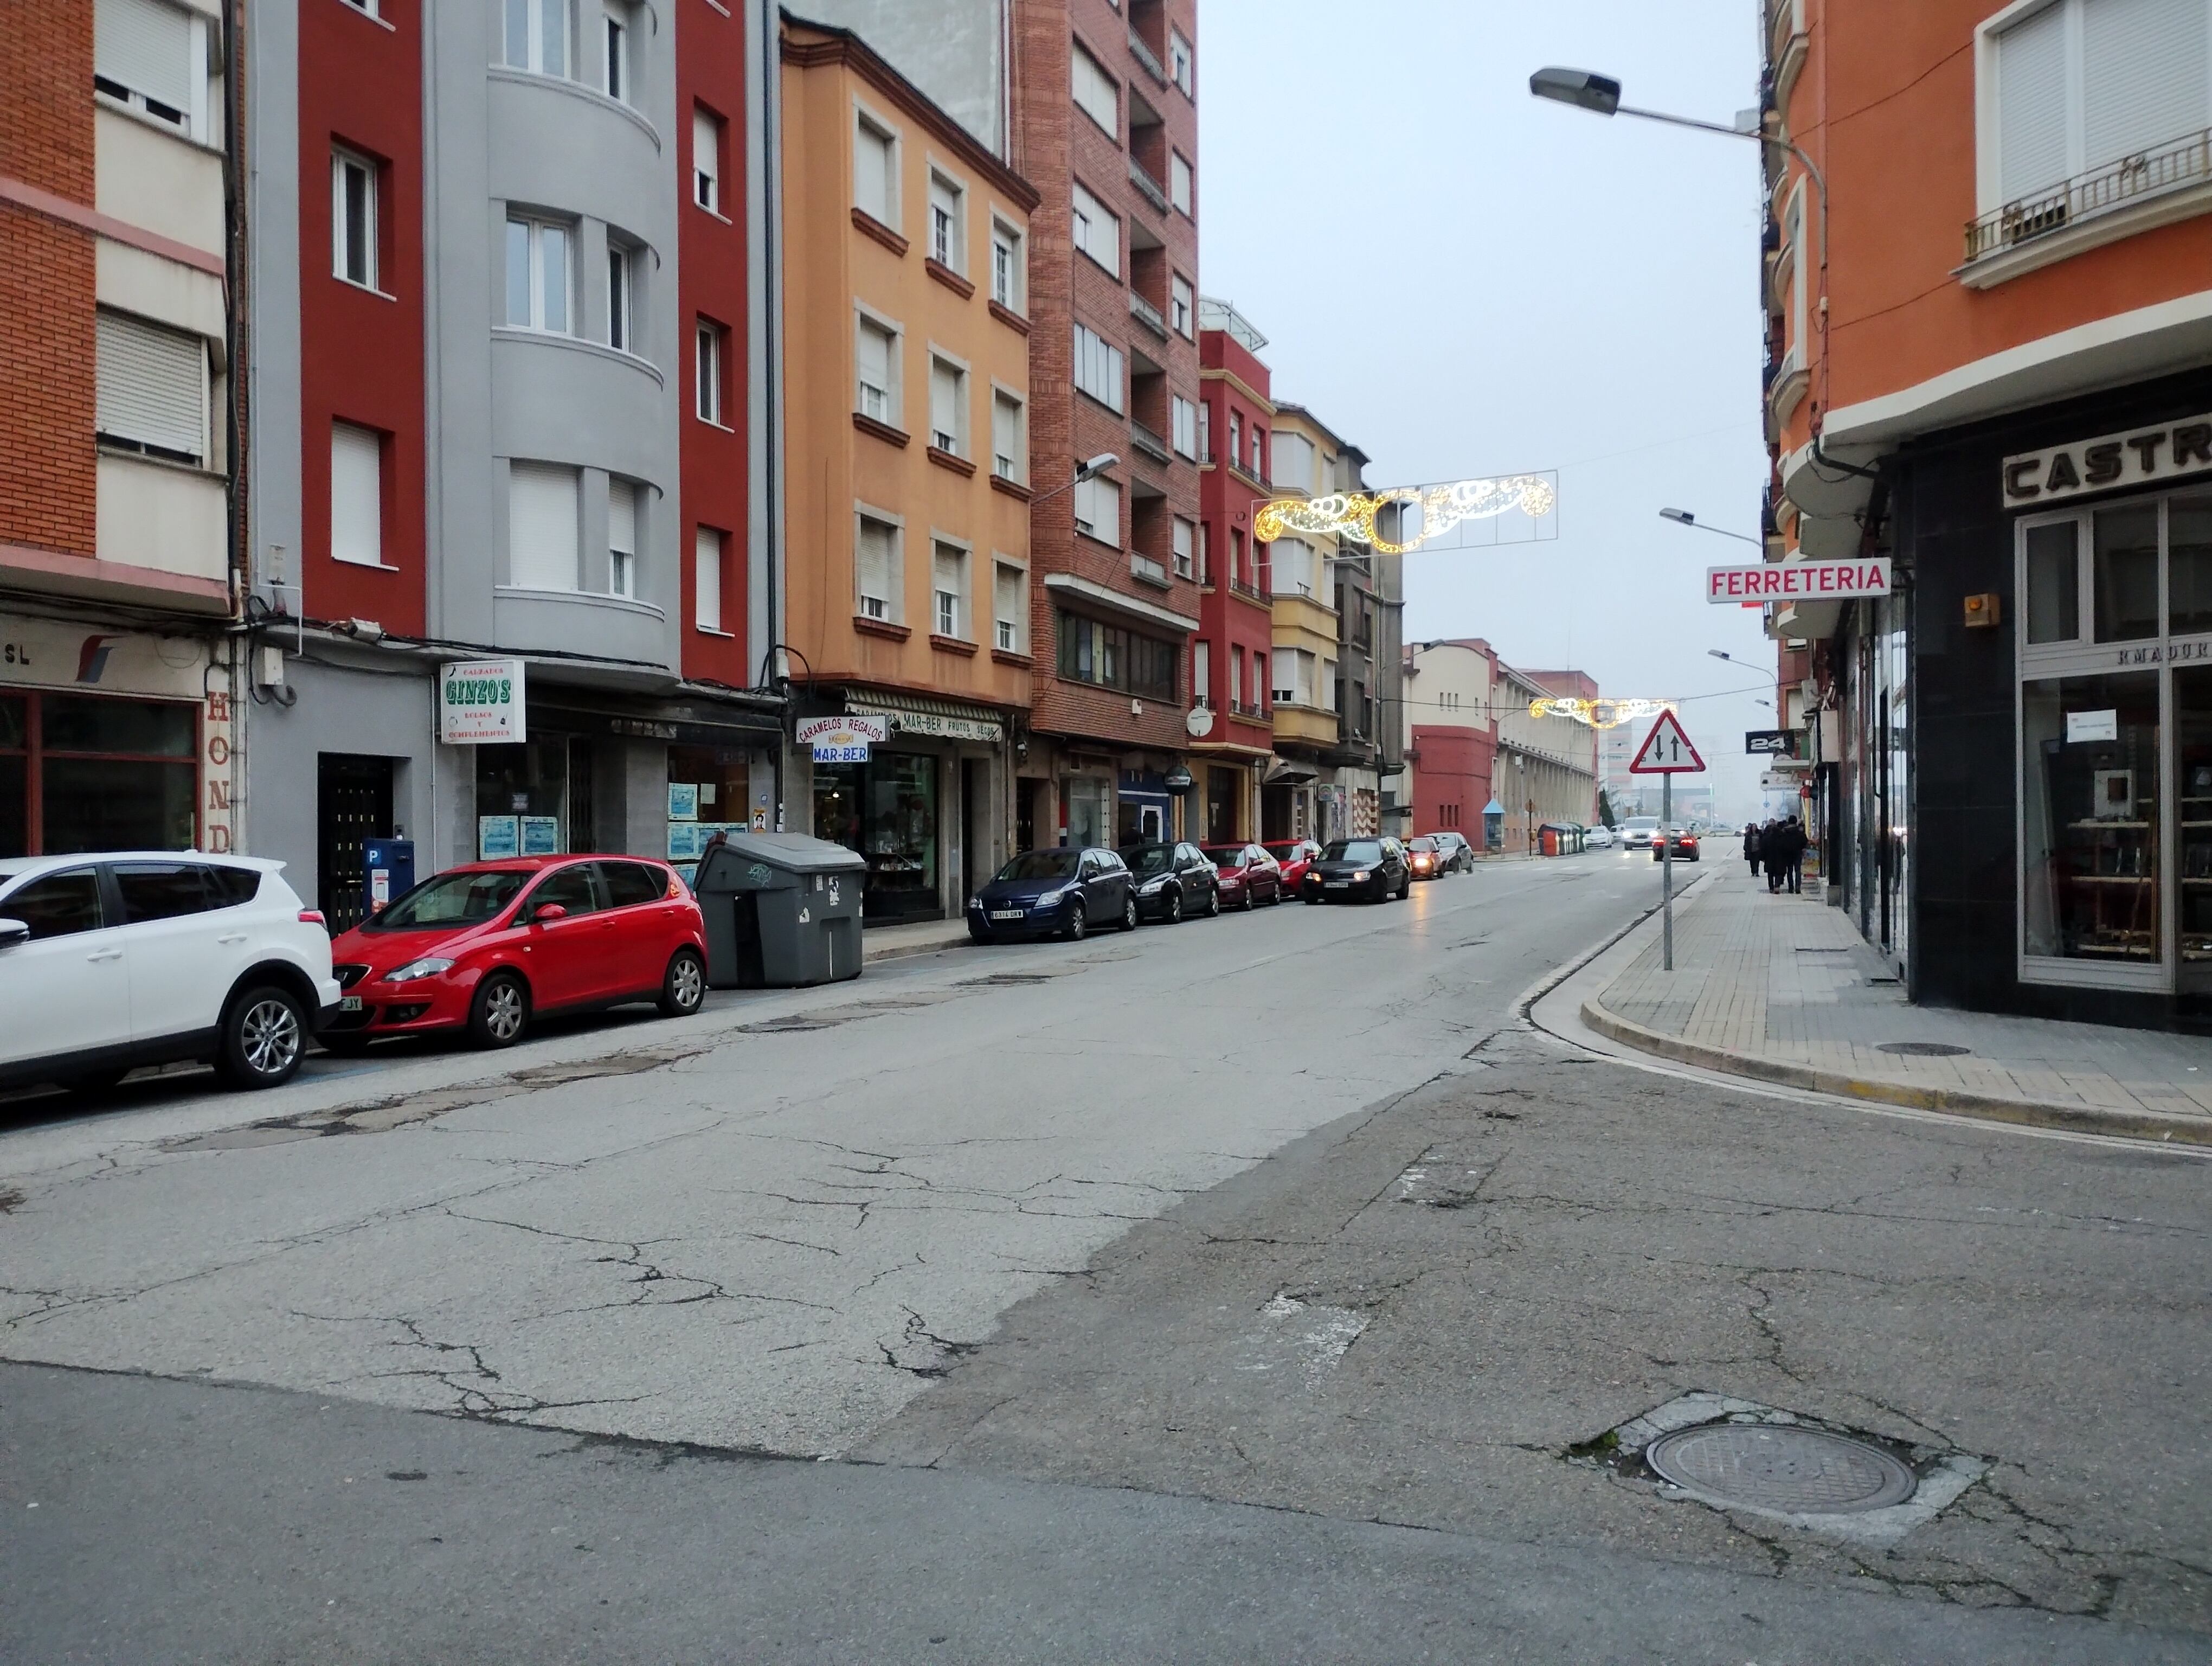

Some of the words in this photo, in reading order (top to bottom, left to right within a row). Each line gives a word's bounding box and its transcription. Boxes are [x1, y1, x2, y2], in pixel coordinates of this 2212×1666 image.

[2006, 422, 2212, 499] CASTR
[1712, 565, 1885, 595] FERRETERIA
[446, 680, 511, 704] GINZO'S
[799, 718, 841, 742] CARAMELOS
[848, 719, 882, 740] REGALOS
[904, 714, 941, 730] MAR-BER
[948, 721, 970, 732] FRUTOS
[814, 747, 867, 761] MAR-BER
[1750, 737, 1786, 750] 24
[369, 850, 378, 862] P
